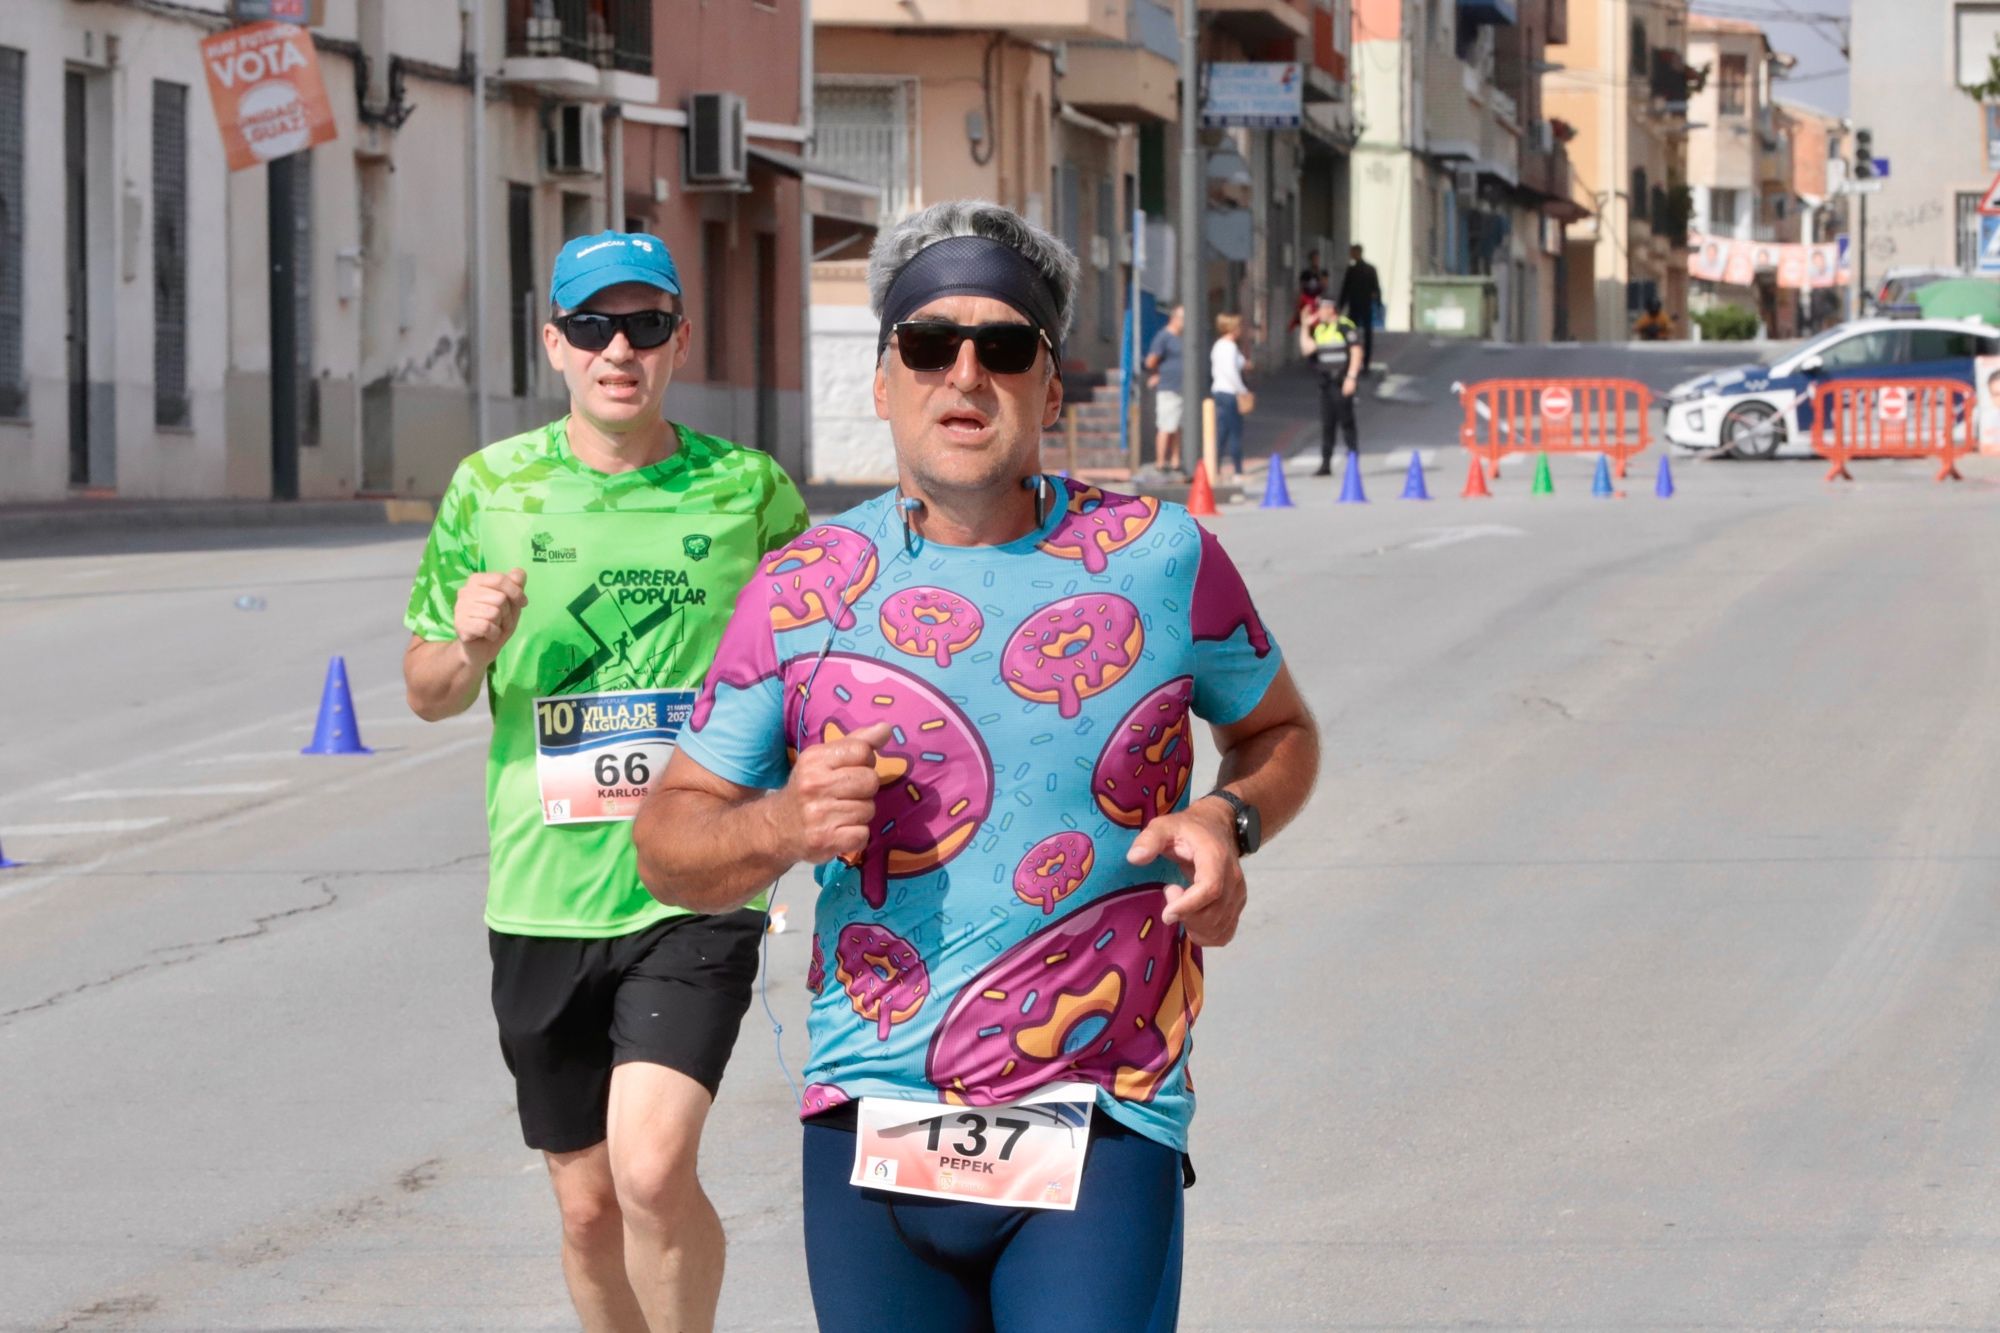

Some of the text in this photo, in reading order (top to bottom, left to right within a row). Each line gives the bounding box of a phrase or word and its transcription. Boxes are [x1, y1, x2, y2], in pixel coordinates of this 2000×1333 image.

[211, 40, 307, 89] VOTA
[598, 569, 689, 587] CARRERA
[618, 587, 706, 606] POPULAR
[580, 702, 657, 721] VILLA DE
[582, 716, 658, 734] ALGUAZAS
[594, 752, 651, 787] 66
[597, 787, 649, 799] KARLOS
[918, 1113, 1030, 1161] 137
[939, 1156, 995, 1175] PEPEK
